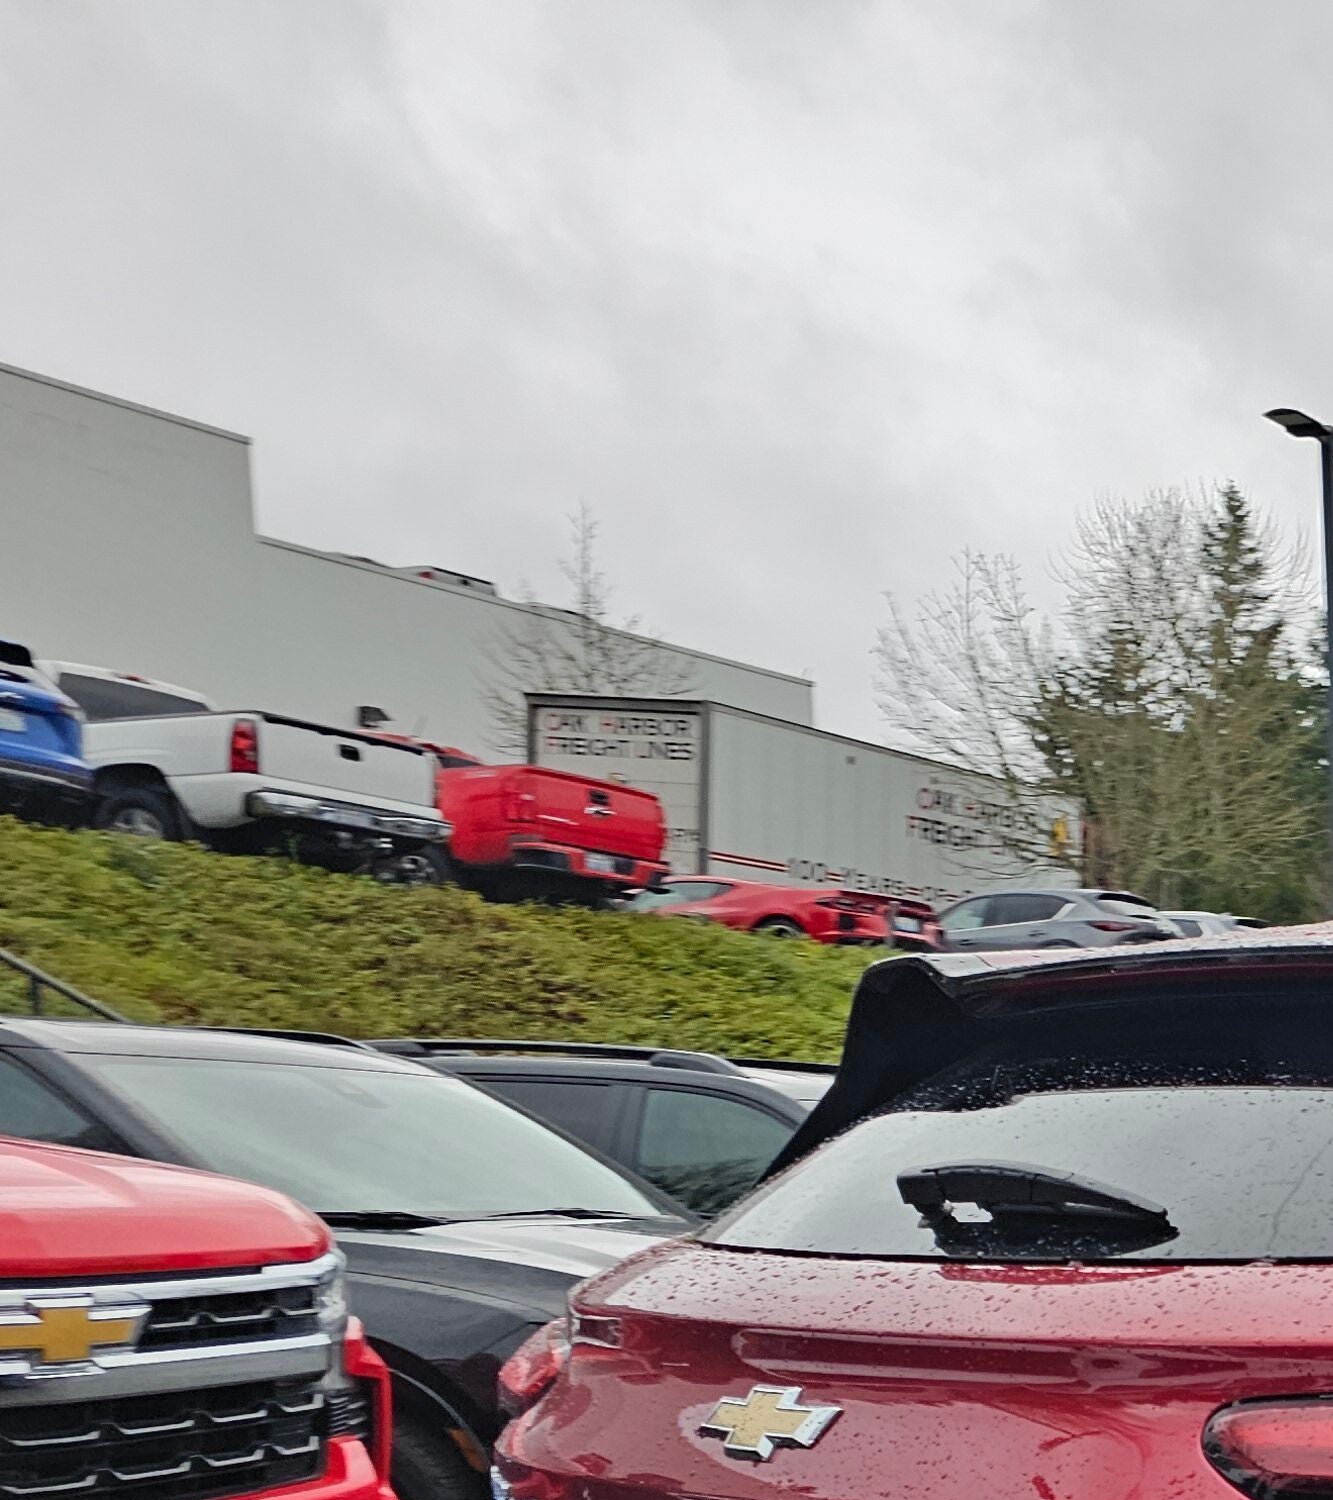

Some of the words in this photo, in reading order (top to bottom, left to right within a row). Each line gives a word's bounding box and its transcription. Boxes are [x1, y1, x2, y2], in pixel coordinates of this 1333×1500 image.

[545, 713, 585, 733] OAK
[600, 716, 690, 738] HARBOR
[545, 735, 629, 757] FREIGHT
[634, 741, 693, 761] LINES
[840, 866, 904, 897] YEARS
